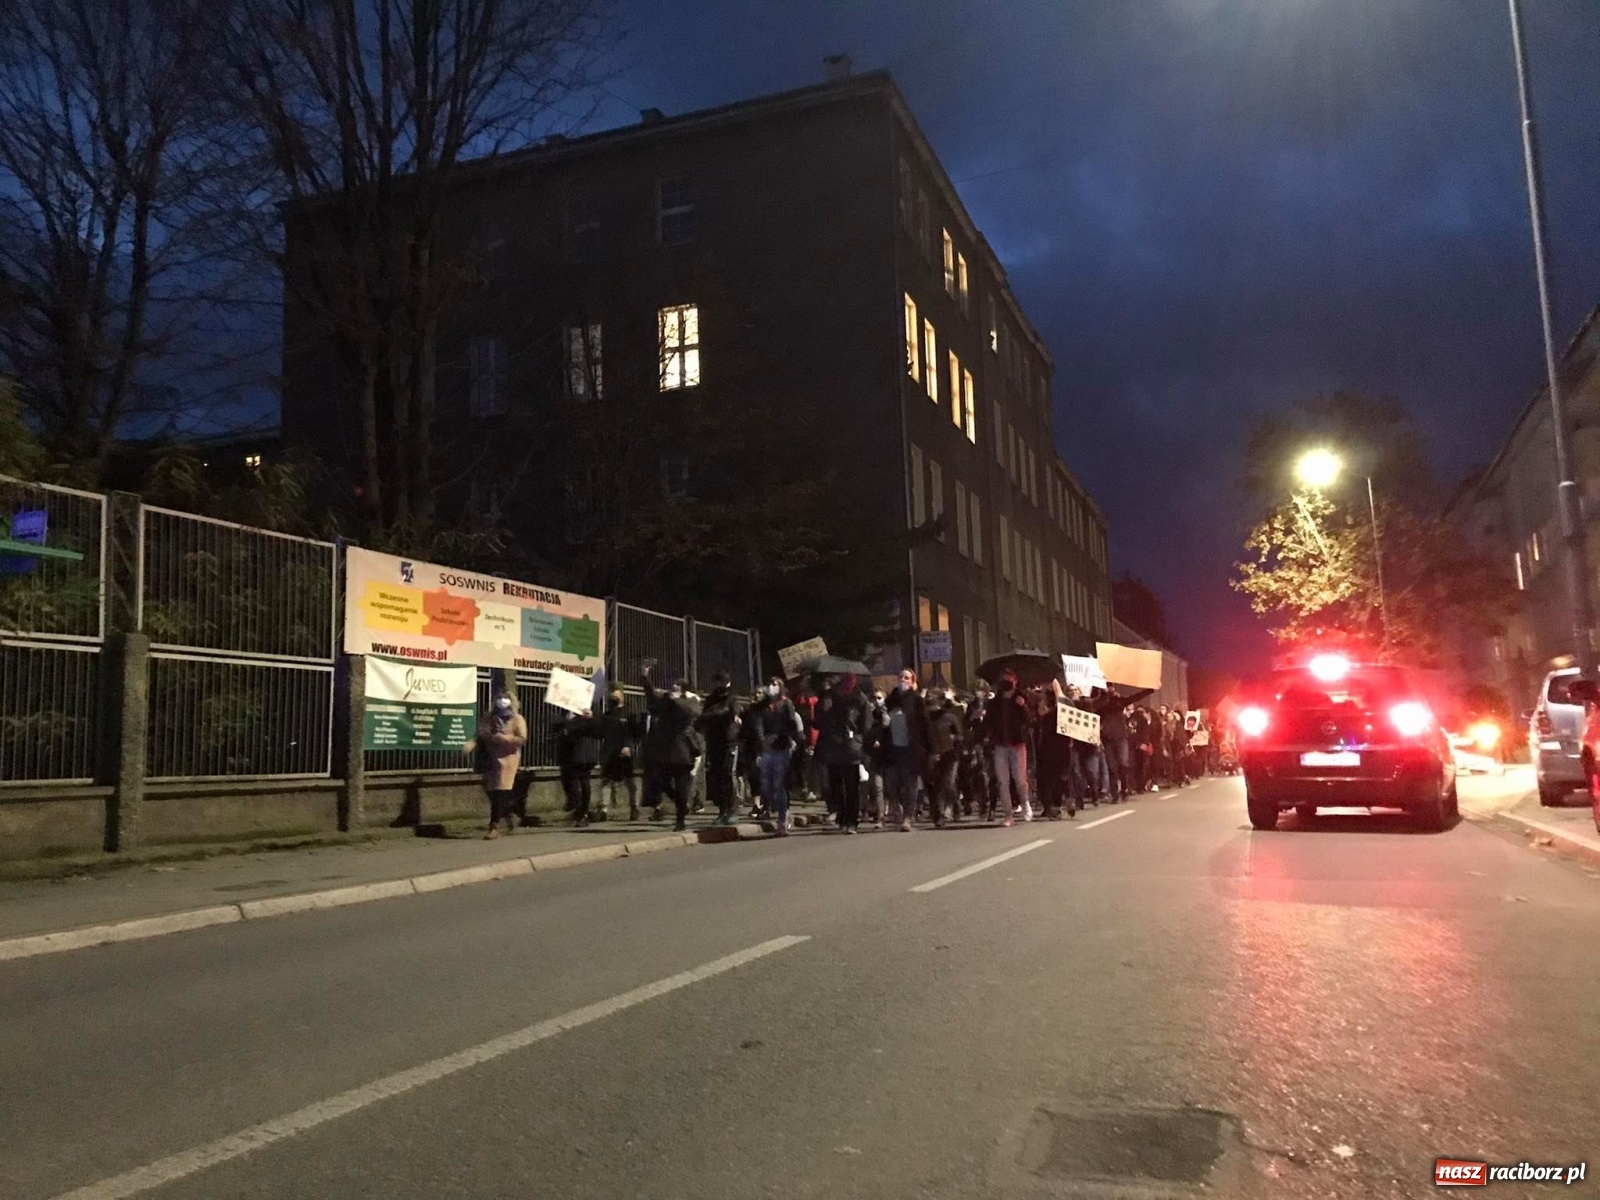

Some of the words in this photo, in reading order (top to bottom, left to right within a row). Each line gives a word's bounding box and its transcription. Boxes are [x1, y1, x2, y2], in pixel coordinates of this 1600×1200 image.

[439, 572, 496, 593] SOSWNIS
[503, 582, 562, 606] REKRUTACJA
[371, 642, 448, 662] www.oswnis.pl
